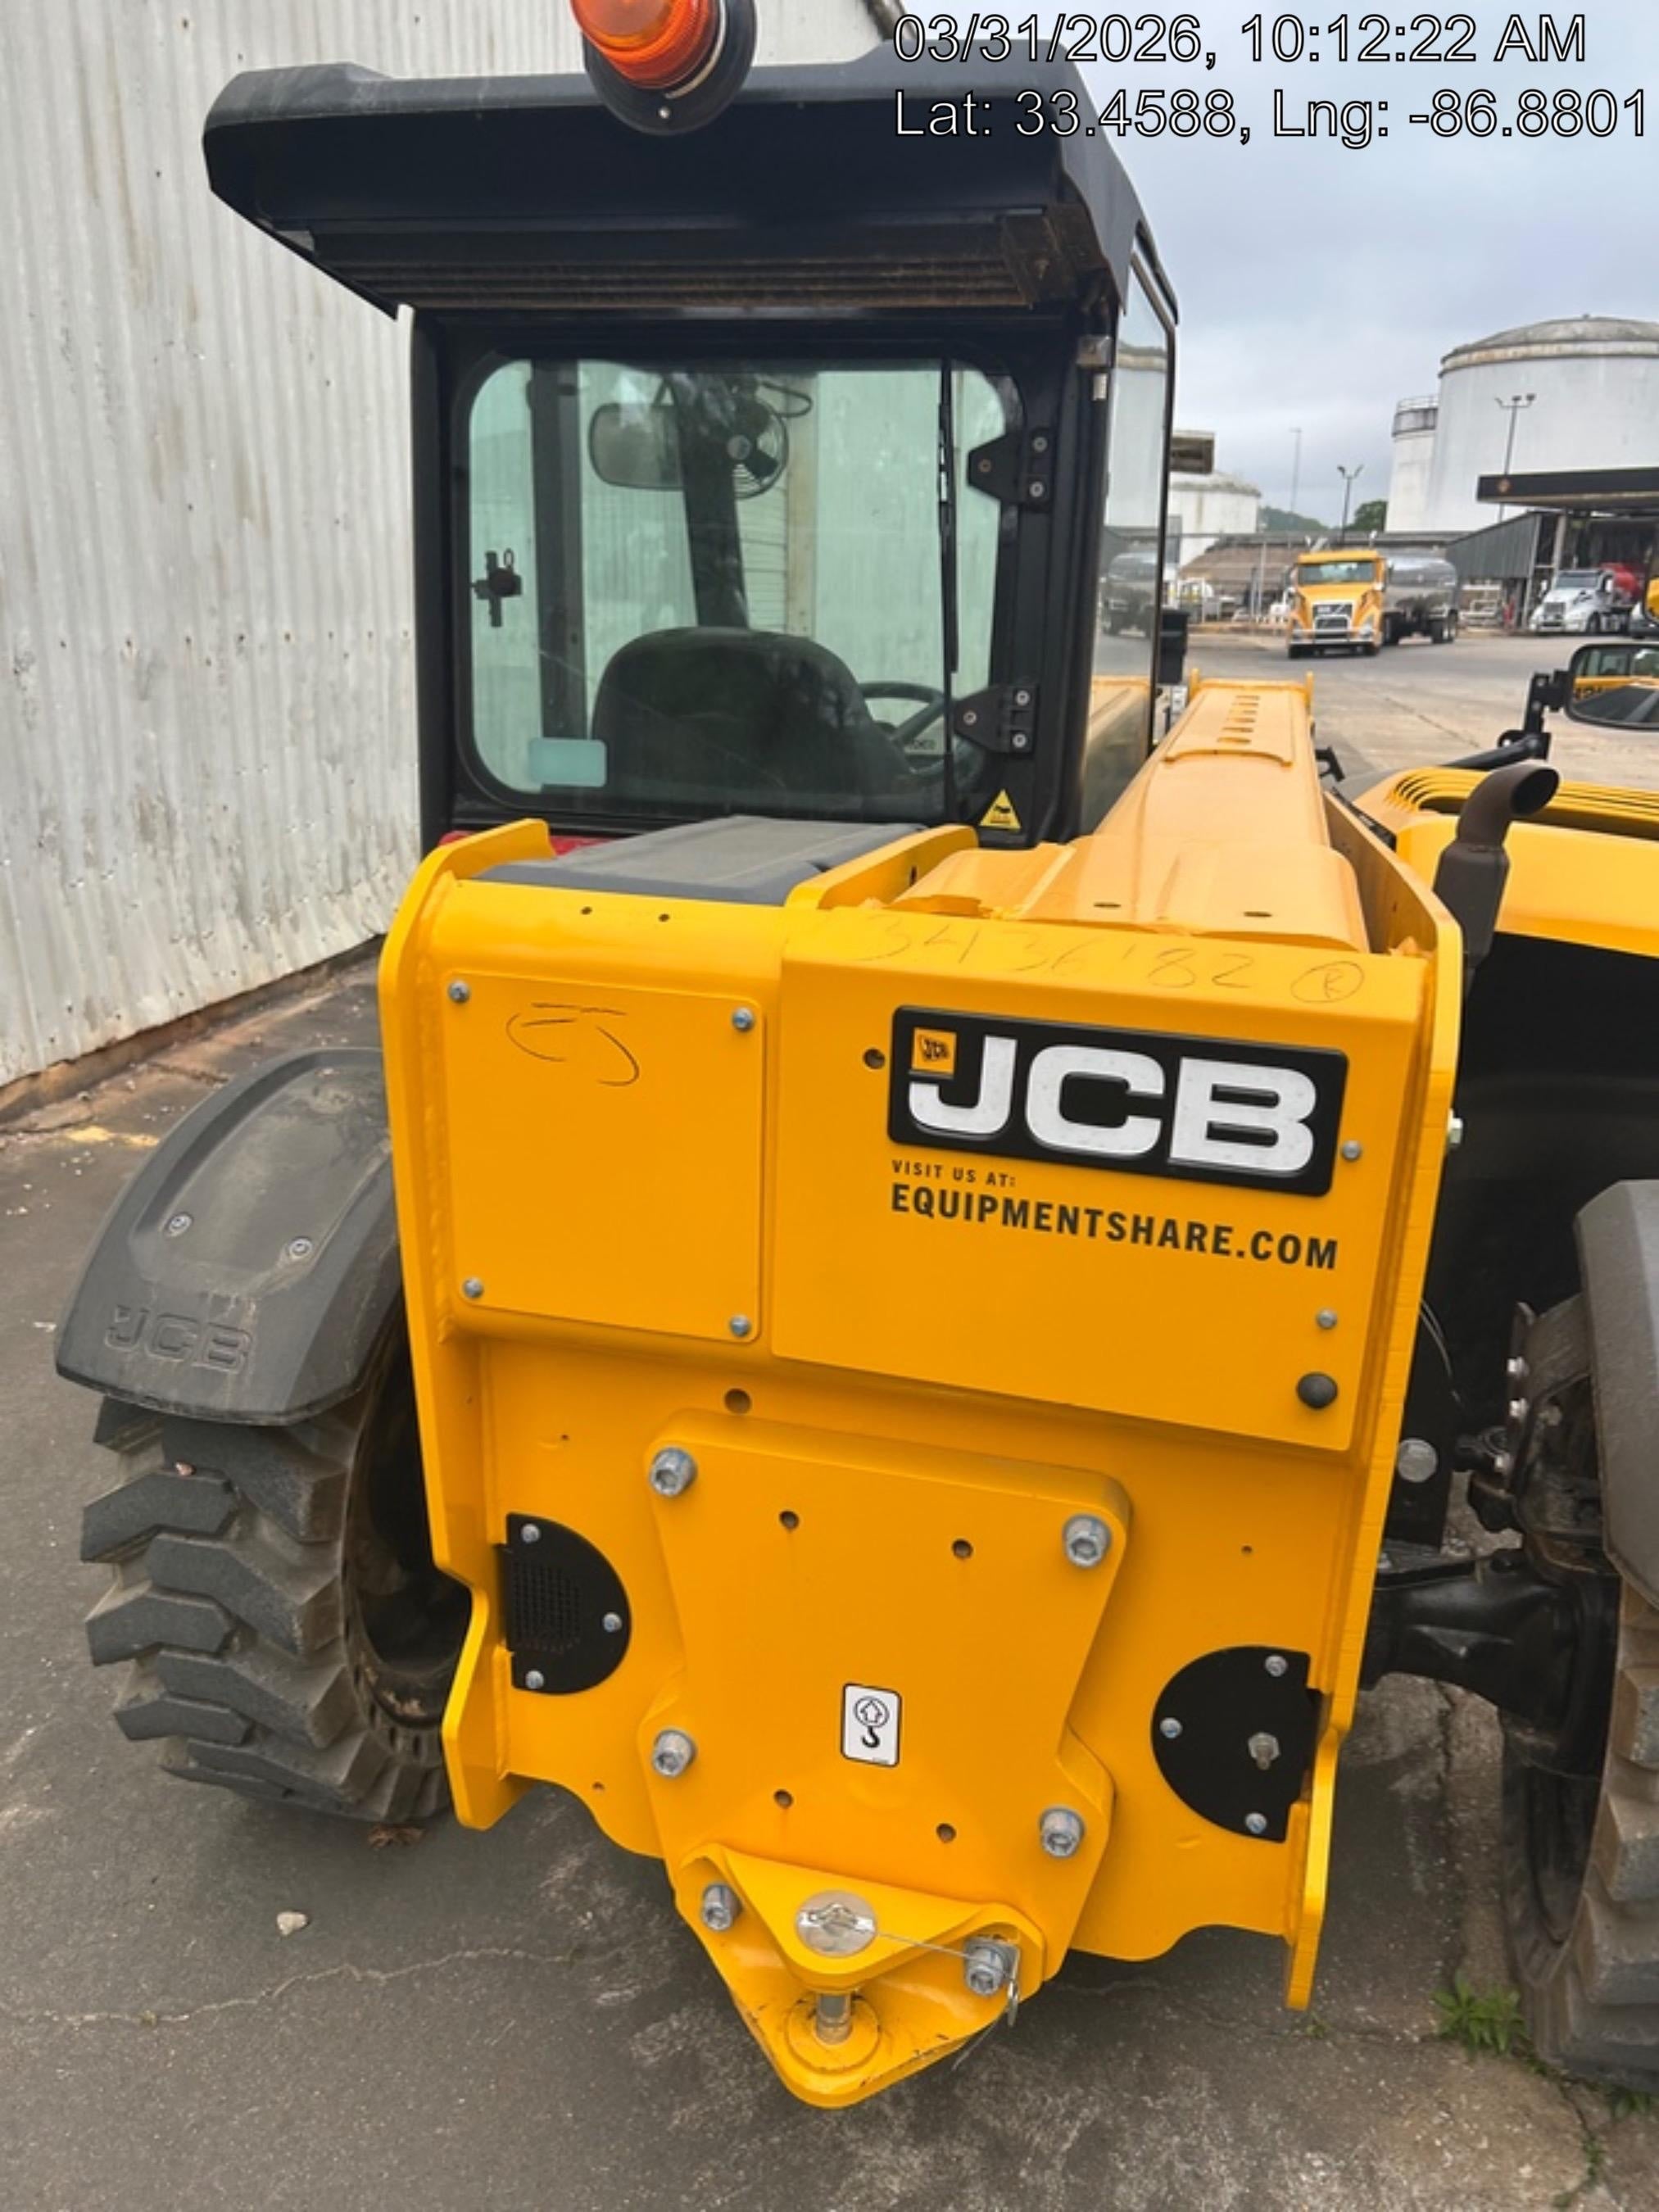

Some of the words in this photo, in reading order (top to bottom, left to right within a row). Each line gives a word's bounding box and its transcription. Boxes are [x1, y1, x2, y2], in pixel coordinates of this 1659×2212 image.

[909, 1035, 1317, 1172] JCB
[891, 1159, 943, 1179] VISIT
[953, 1167, 977, 1183] US
[986, 1172, 1017, 1187] AT:
[891, 1182, 1339, 1270] EQUIPMENTSHARE.COM
[105, 1304, 254, 1374] JCB
